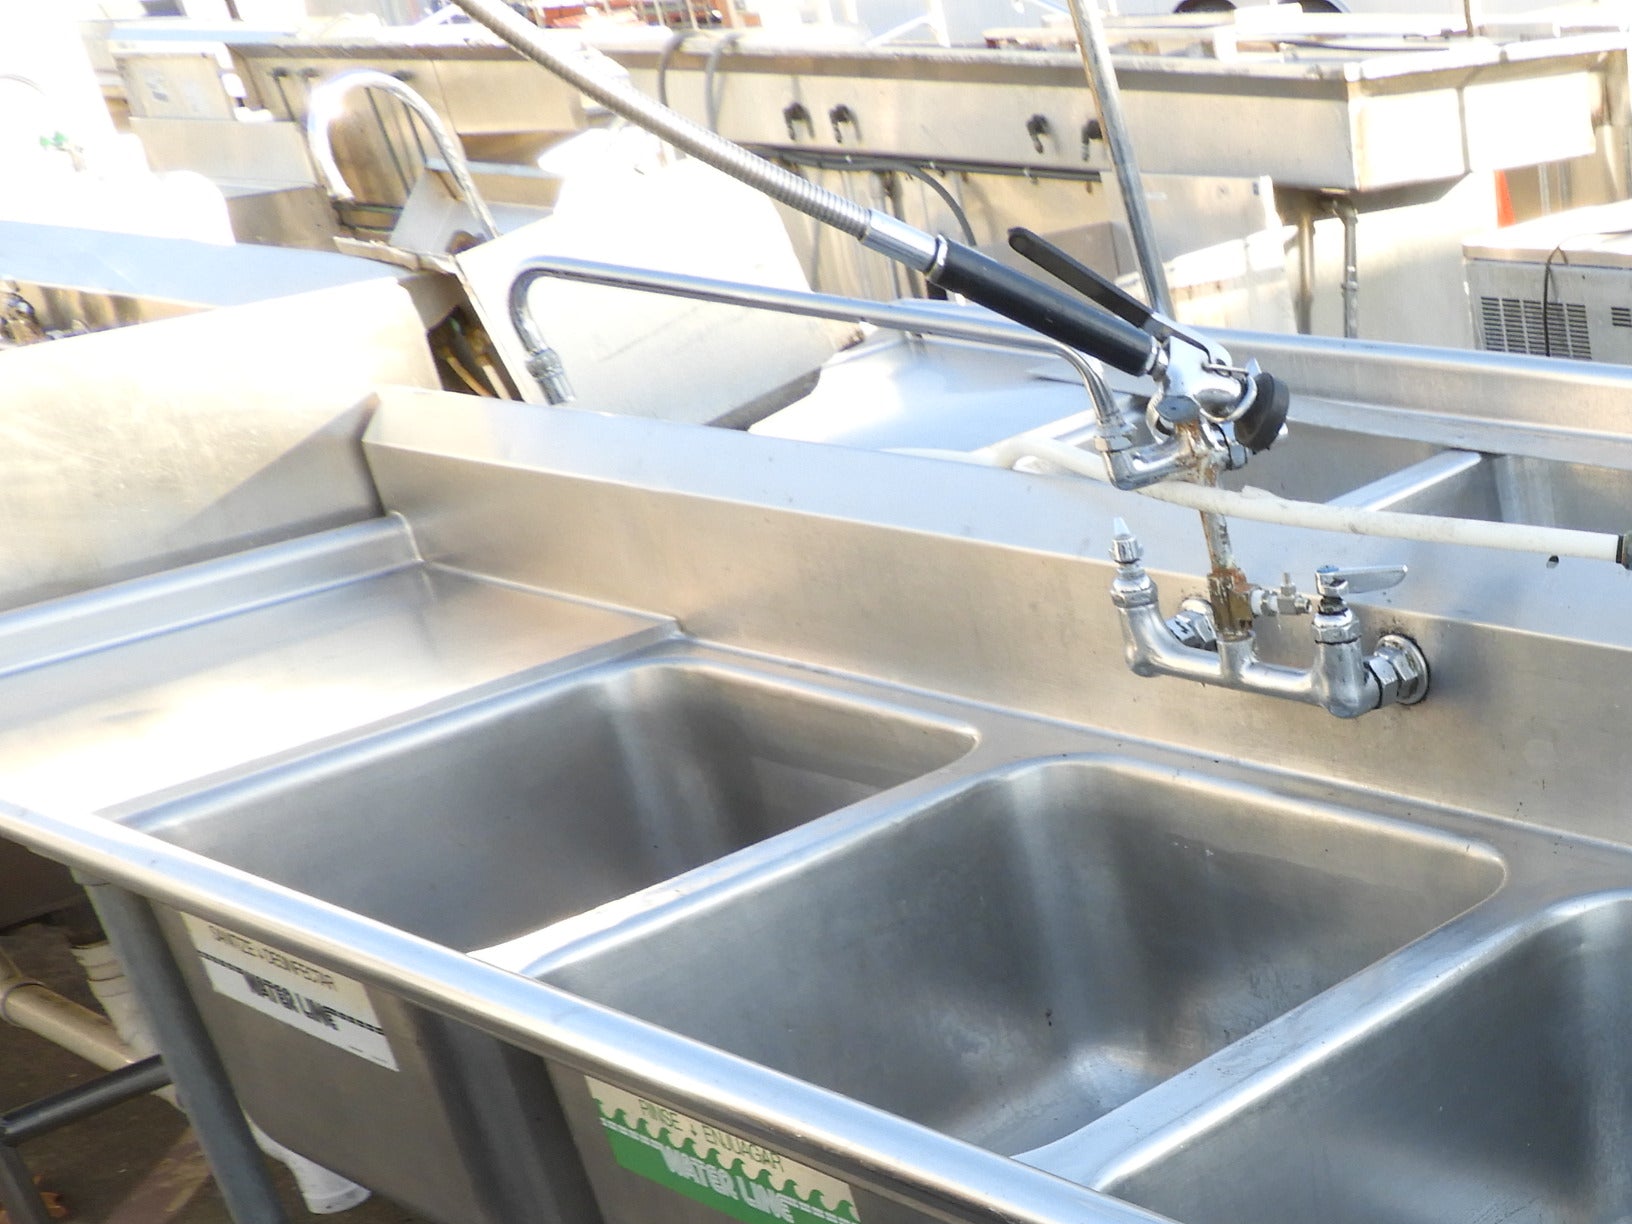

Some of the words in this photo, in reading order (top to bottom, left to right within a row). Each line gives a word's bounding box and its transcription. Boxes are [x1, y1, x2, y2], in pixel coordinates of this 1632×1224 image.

[637, 1099, 684, 1133] RINSE
[660, 1146, 740, 1201] WATER
[735, 1175, 796, 1224] LINE
